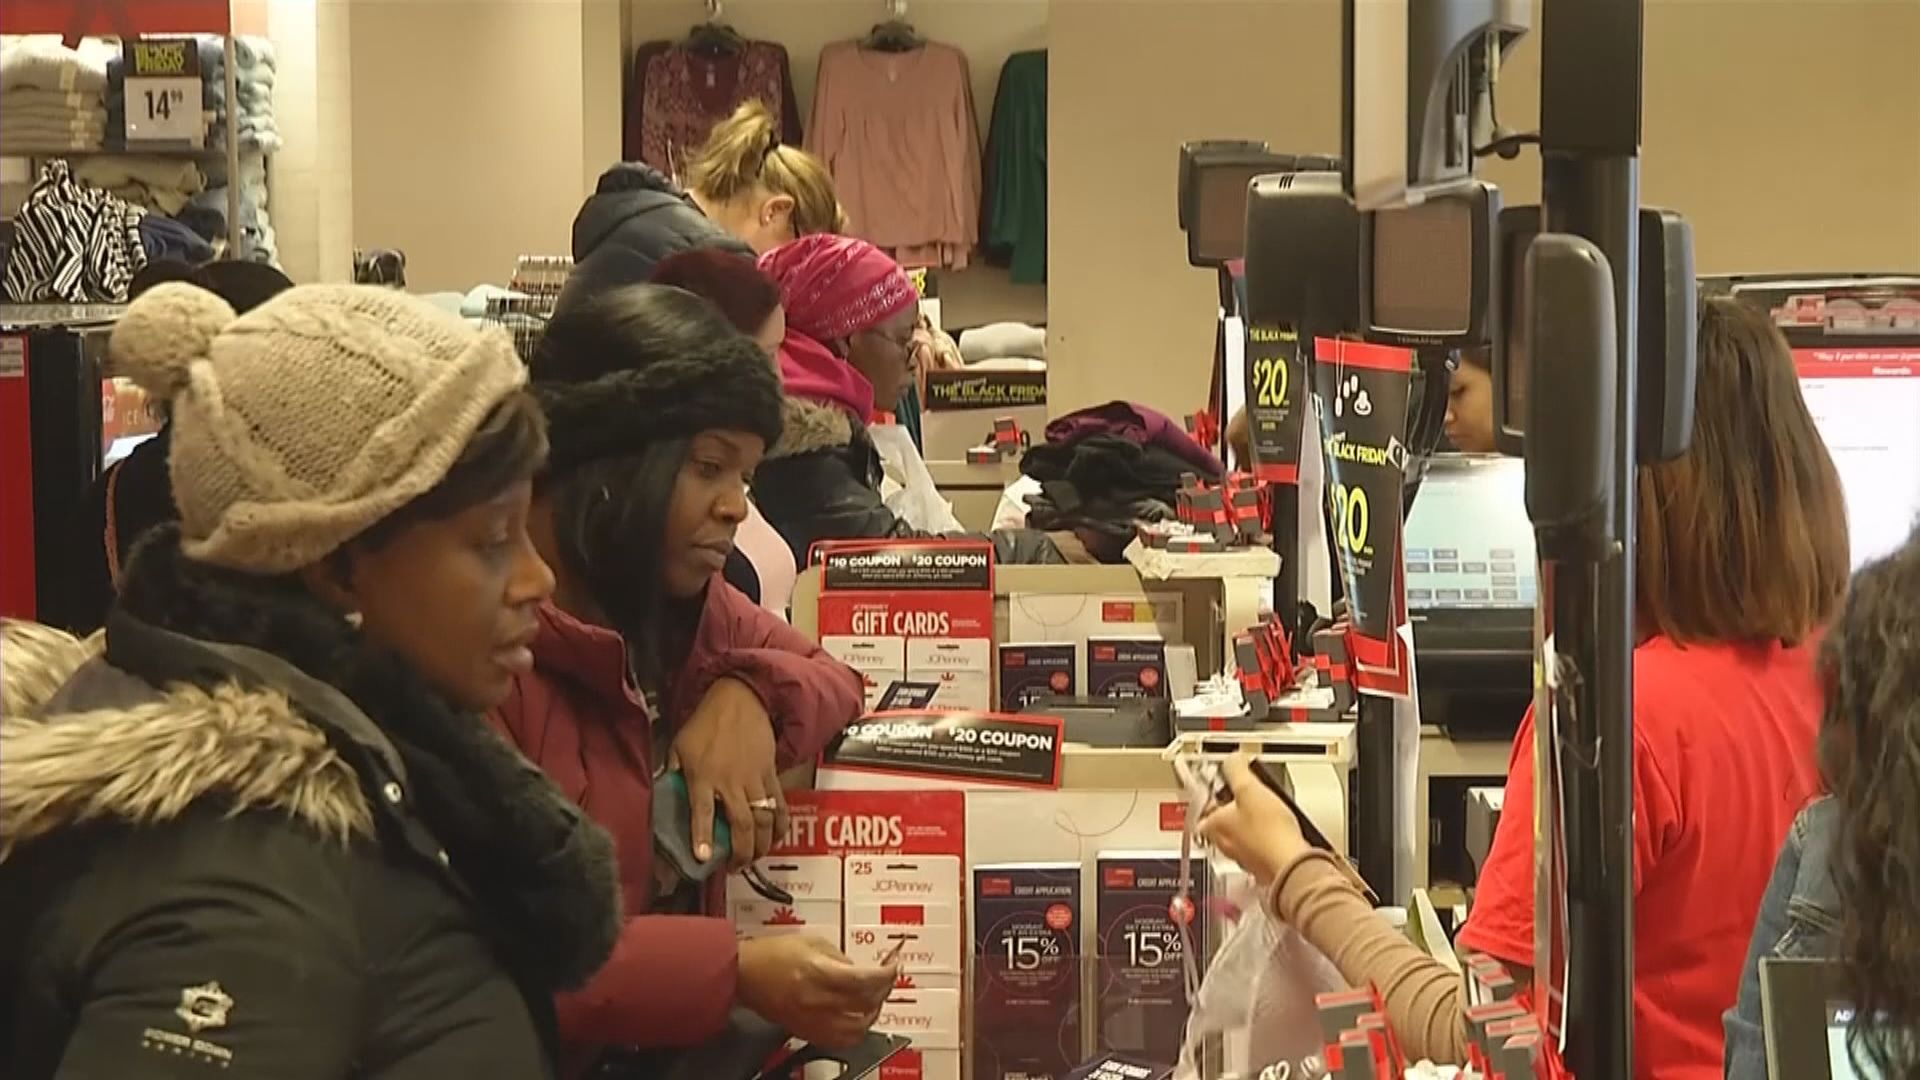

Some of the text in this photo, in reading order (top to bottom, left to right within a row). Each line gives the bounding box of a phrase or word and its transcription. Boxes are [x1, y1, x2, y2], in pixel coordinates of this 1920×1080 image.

[932, 384, 1045, 398] THE BLACK FRIDA
[1253, 359, 1288, 406] $20
[1356, 446, 1388, 467] FRIDAY
[850, 555, 901, 567] COUPON
[935, 555, 987, 567] COUPON
[852, 612, 889, 635] GIFT
[893, 612, 949, 635] CARDS
[861, 723, 935, 740] COUPON
[949, 725, 977, 744] $20
[980, 729, 1053, 751] COUPON
[824, 816, 903, 847] CARDS
[872, 881, 933, 894] JCPenney
[1035, 886, 1073, 896] APPLICATION
